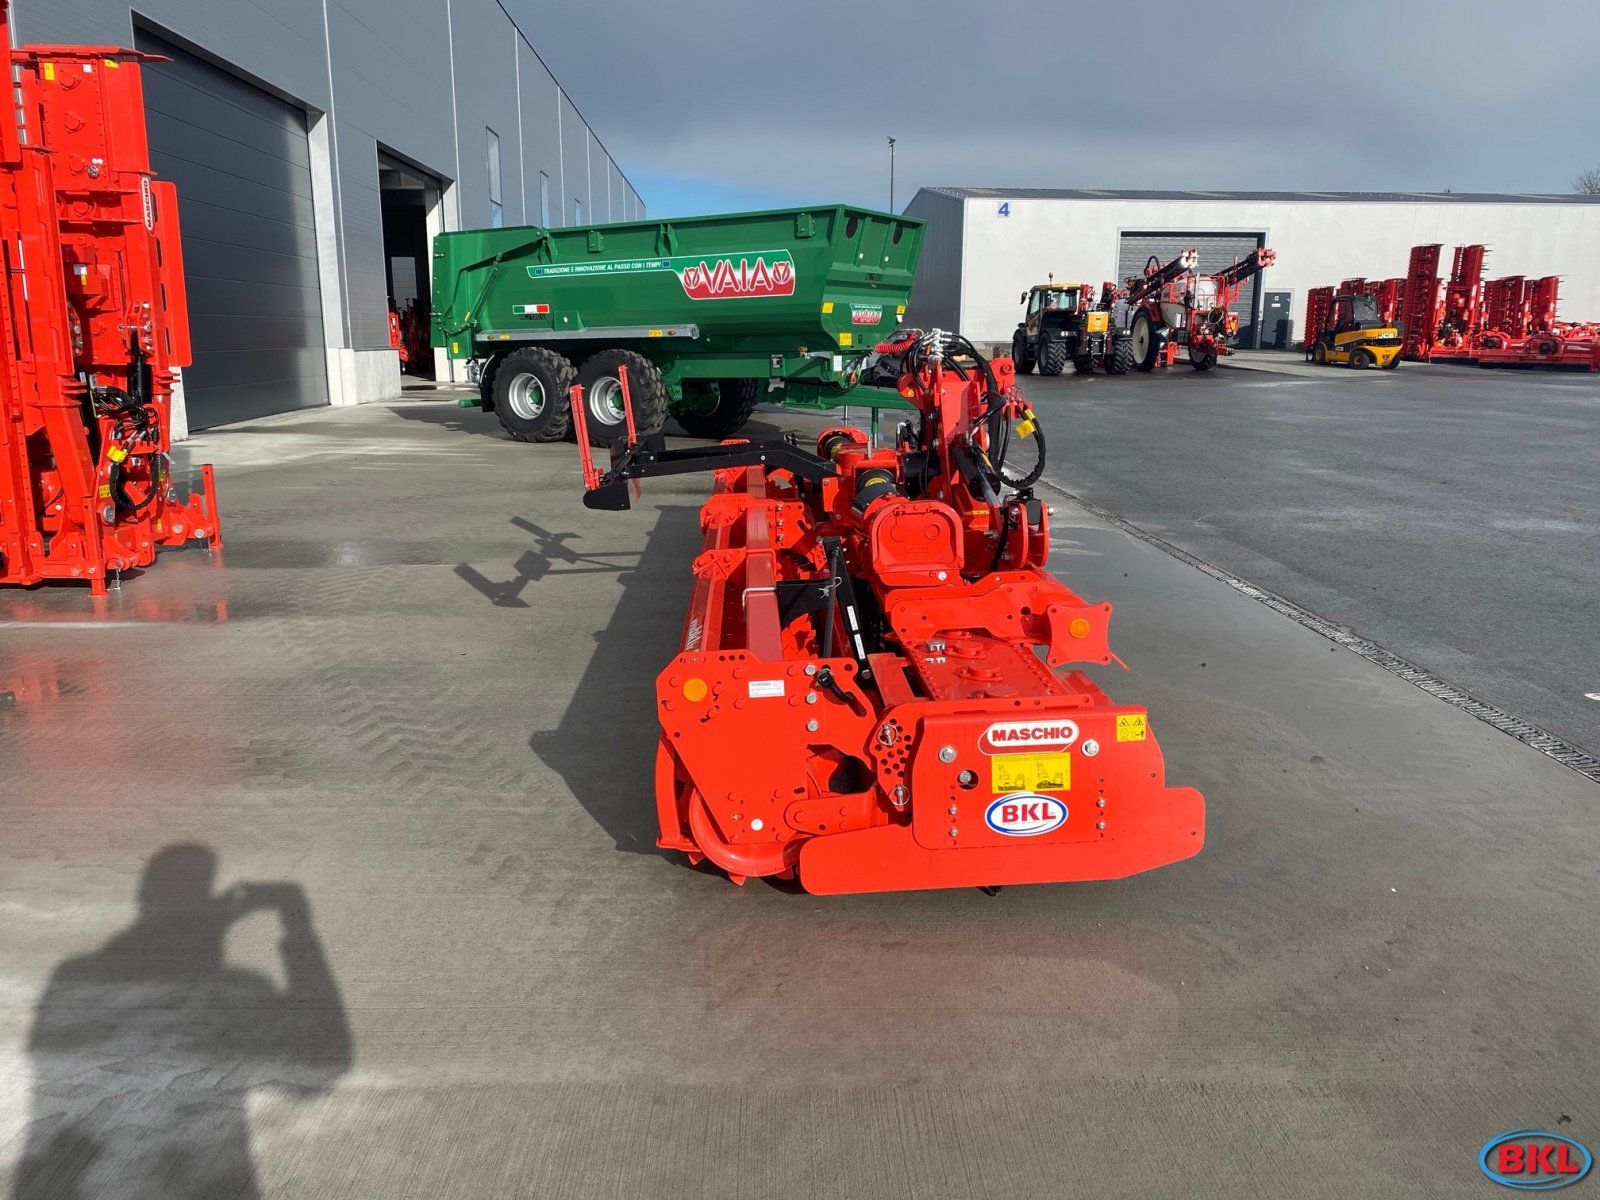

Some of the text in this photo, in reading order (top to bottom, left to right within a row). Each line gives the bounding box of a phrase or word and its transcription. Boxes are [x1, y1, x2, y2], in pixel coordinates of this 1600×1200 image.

[144, 180, 152, 228] MASCHIO
[998, 202, 1010, 217] 4
[575, 264, 606, 272] INNOVAZIONE
[700, 257, 774, 294] VAIA
[992, 726, 1073, 742] MASCHIO
[1002, 802, 1056, 823] BKL
